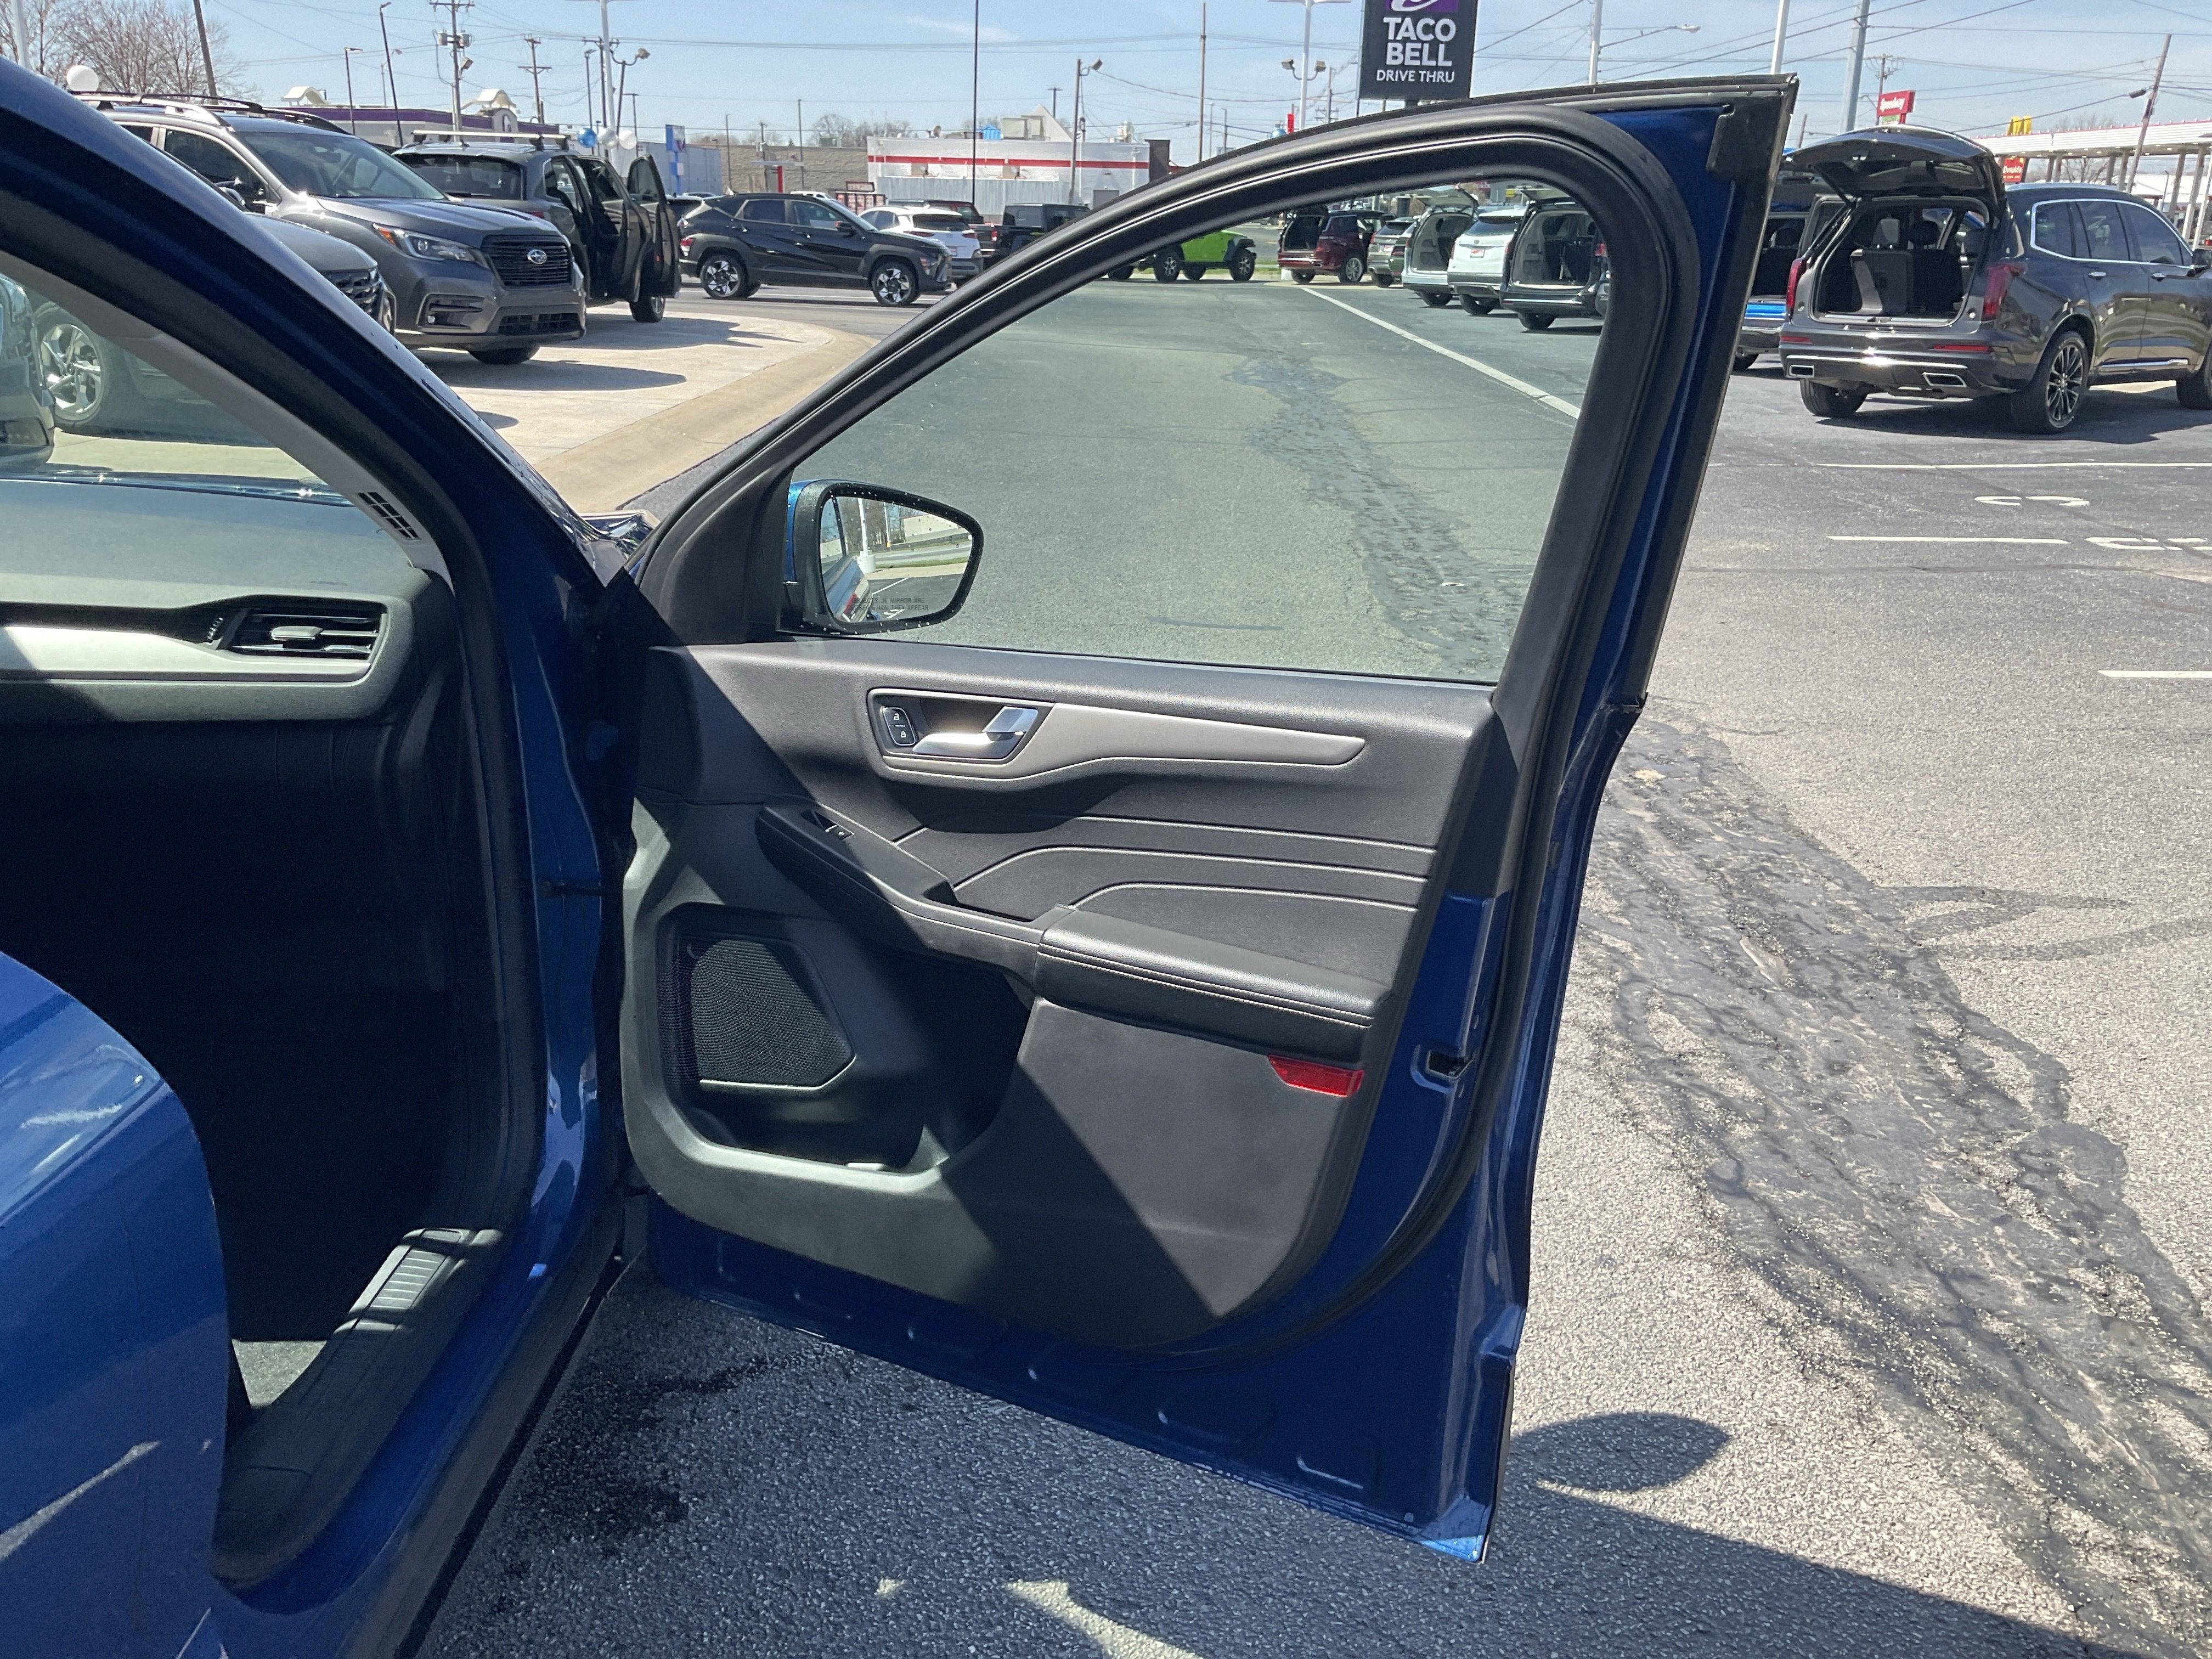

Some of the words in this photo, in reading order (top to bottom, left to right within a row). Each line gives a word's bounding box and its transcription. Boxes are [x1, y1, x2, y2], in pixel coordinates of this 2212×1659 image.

[1383, 17, 1456, 42] TACO
[1386, 42, 1453, 66] BELL
[1376, 70, 1415, 82] DRIVE
[1419, 71, 1455, 83] THRU
